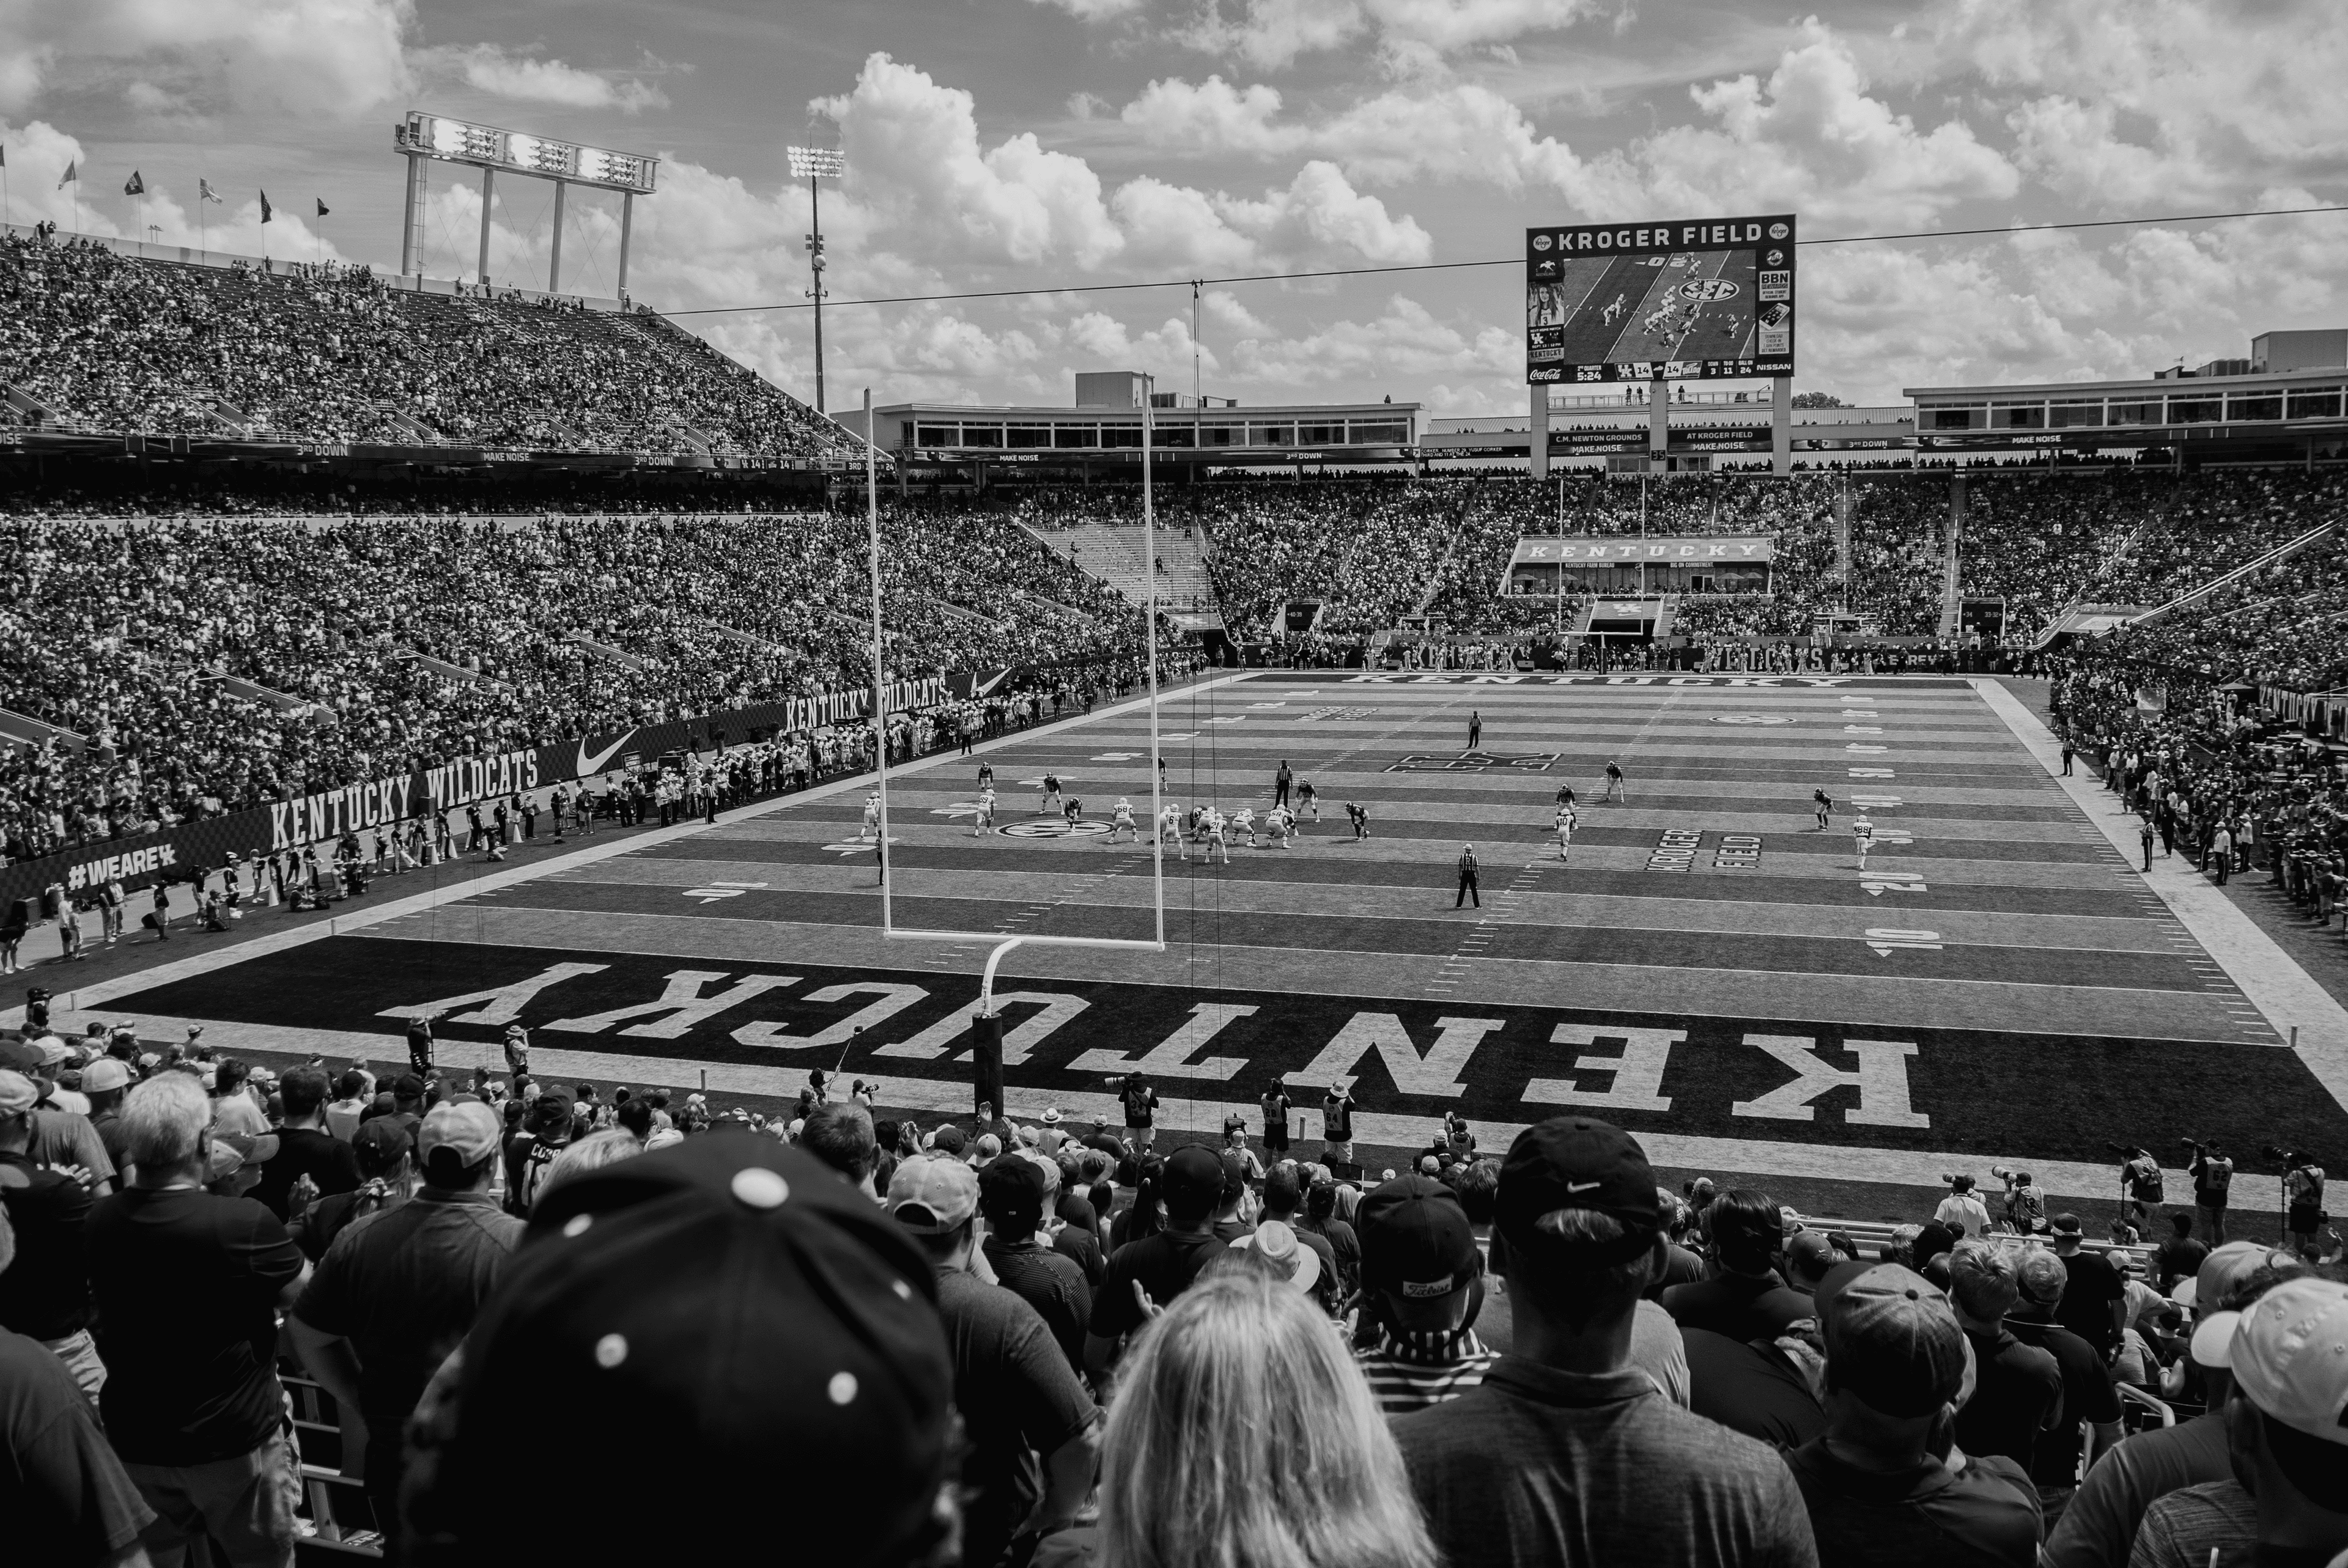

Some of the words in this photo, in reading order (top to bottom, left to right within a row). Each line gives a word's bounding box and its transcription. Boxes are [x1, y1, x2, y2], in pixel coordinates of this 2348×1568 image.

[1771, 226, 1787, 237] Kroger
[1535, 237, 1550, 248] Kroger
[1559, 228, 1670, 251] KROGER
[1683, 224, 1762, 245] FIELD
[1762, 273, 1789, 284] BBN
[1530, 348, 1562, 358] KENTUCKY
[1577, 371, 1602, 381] 5:24
[0, 432, 23, 445] ISE
[1606, 433, 1642, 442] GROUNDS
[297, 444, 313, 456] 3RD
[314, 444, 348, 457] DOWN
[1571, 445, 1595, 454] MAKE
[1596, 444, 1622, 452] NOISE
[1693, 443, 1716, 451] MAKE
[483, 452, 505, 462] MAKE
[506, 452, 530, 462] NOISE
[1652, 451, 1665, 460] 35
[648, 456, 673, 466] DOWN
[751, 459, 761, 469] 14
[780, 460, 789, 469] 14
[805, 461, 821, 470] 5:24
[848, 462, 862, 471] 3RD
[1529, 545, 1757, 558] KENTUCKY
[1342, 675, 1851, 687] KENTUCKY
[786, 688, 868, 732] KENTUCKY
[271, 774, 412, 851] KENTUCKY
[426, 748, 538, 810] WILDCATS
[1168, 815, 1174, 824] 6
[1560, 817, 1568, 826] 10
[1858, 825, 1869, 834] 88
[1645, 829, 1705, 872] KROGER
[1713, 836, 1763, 869] FIELD
[1465, 857, 1471, 866] R
[374, 962, 1930, 1129] KENTUCKY
[1131, 1100, 1143, 1111] 34
[1265, 1108, 1277, 1118] 28
[1326, 1111, 1338, 1123] 64
[2212, 1169, 2228, 1182] 62
[1405, 1284, 1451, 1297] Titleist
